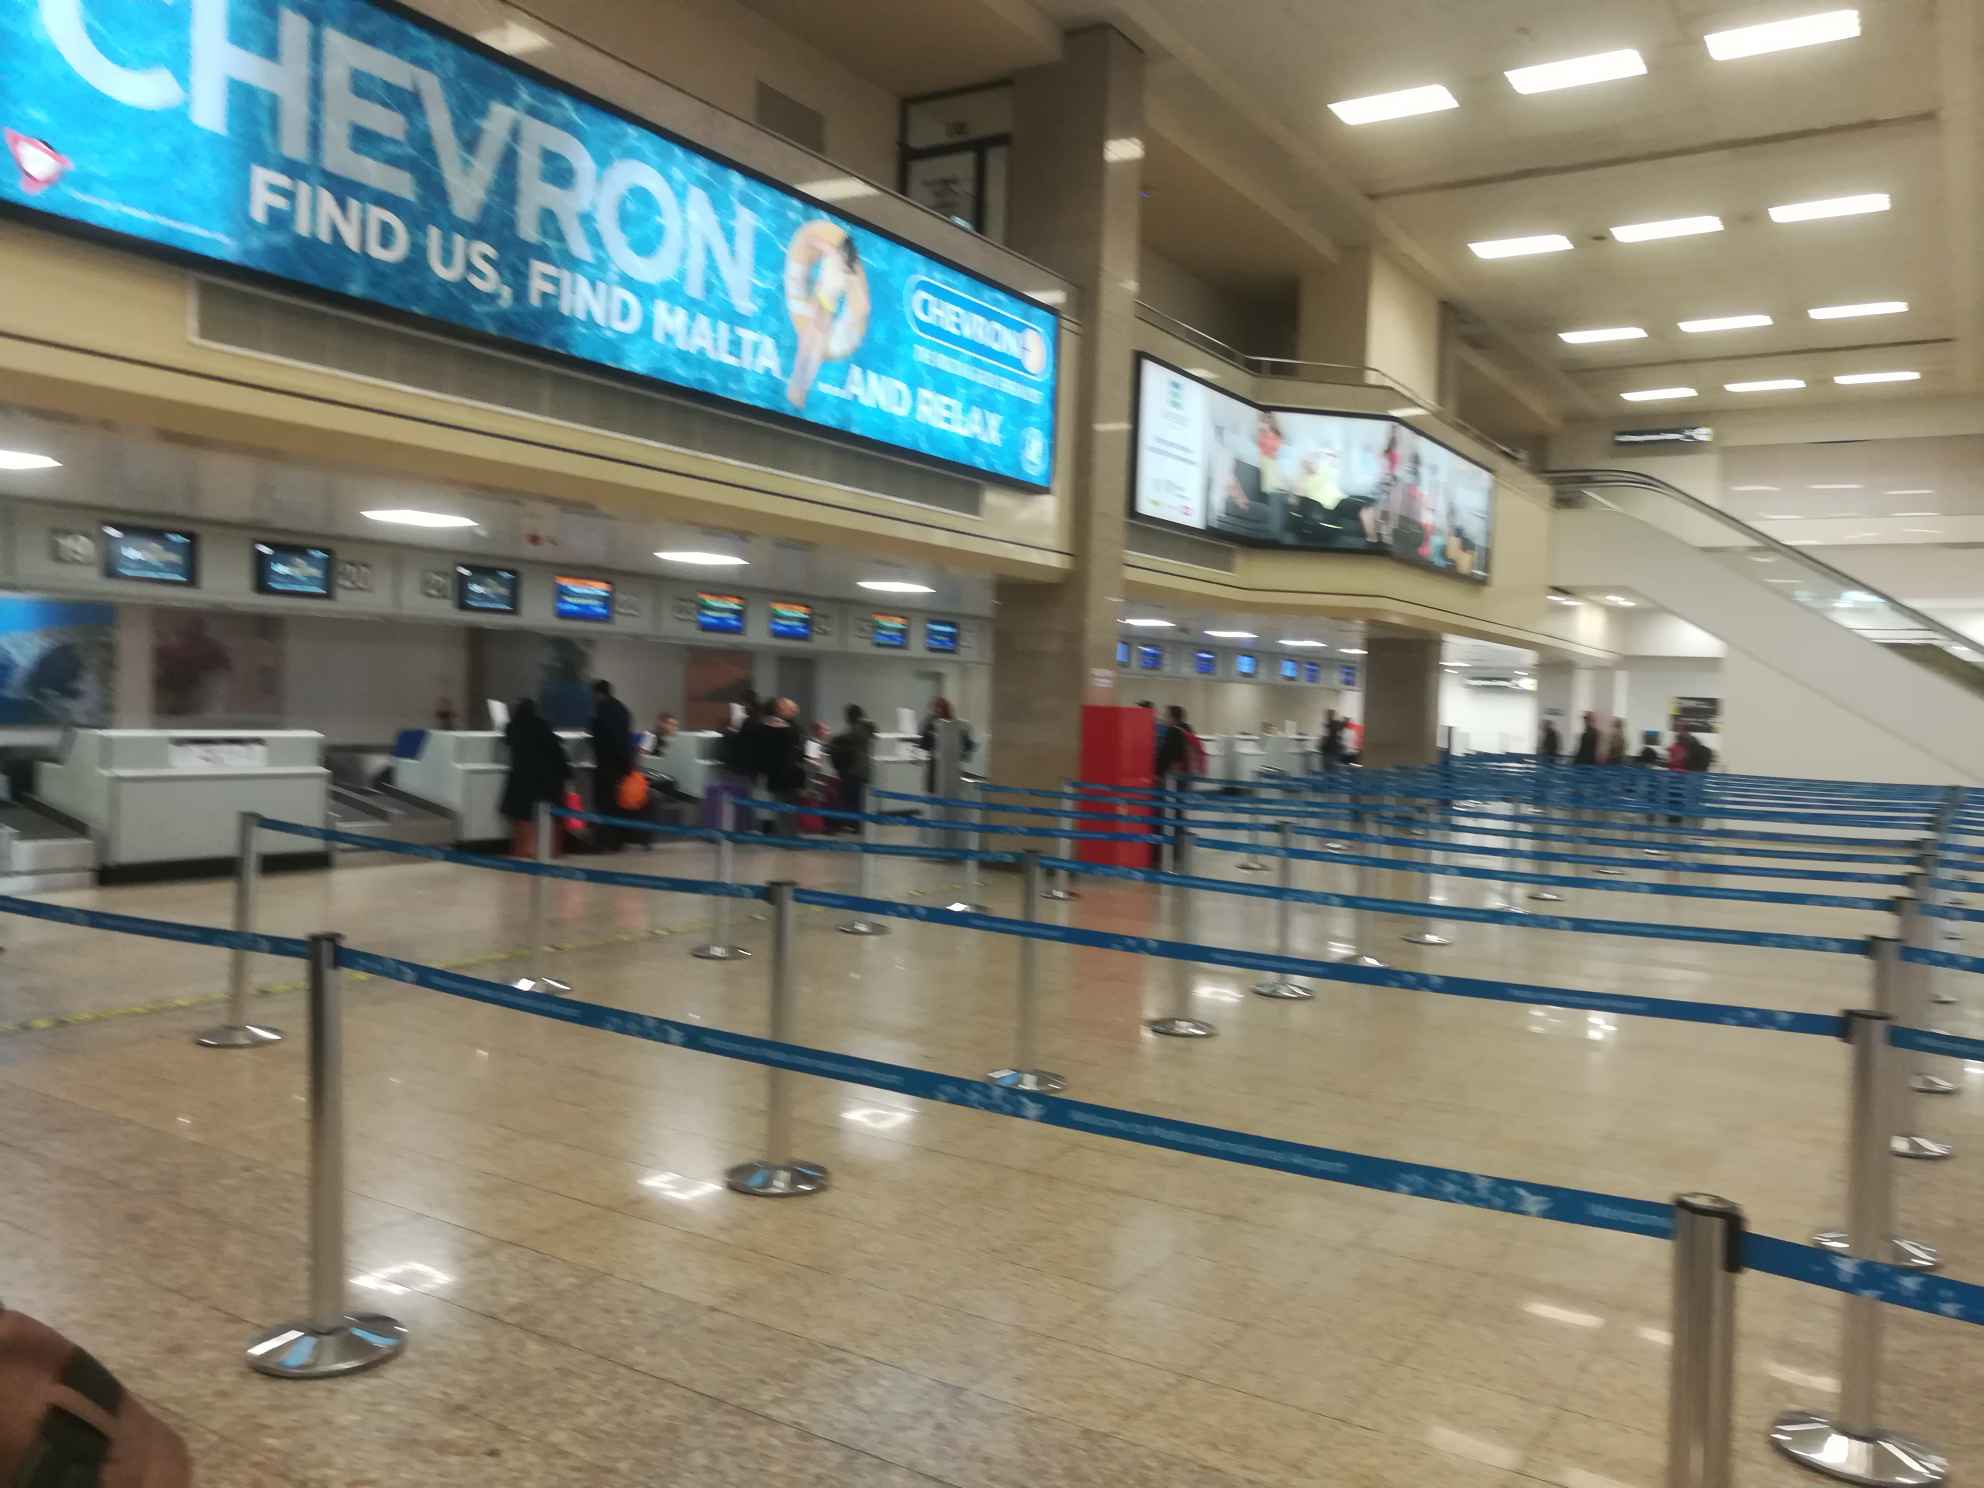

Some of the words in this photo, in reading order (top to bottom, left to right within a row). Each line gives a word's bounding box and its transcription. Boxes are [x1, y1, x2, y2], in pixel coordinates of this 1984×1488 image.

[40, 0, 758, 317] CHEVRON
[249, 164, 410, 264] FIND
[426, 223, 514, 308] US,
[528, 259, 642, 334] FIND
[652, 303, 784, 379] MALTA
[915, 387, 1004, 447] RELAX
